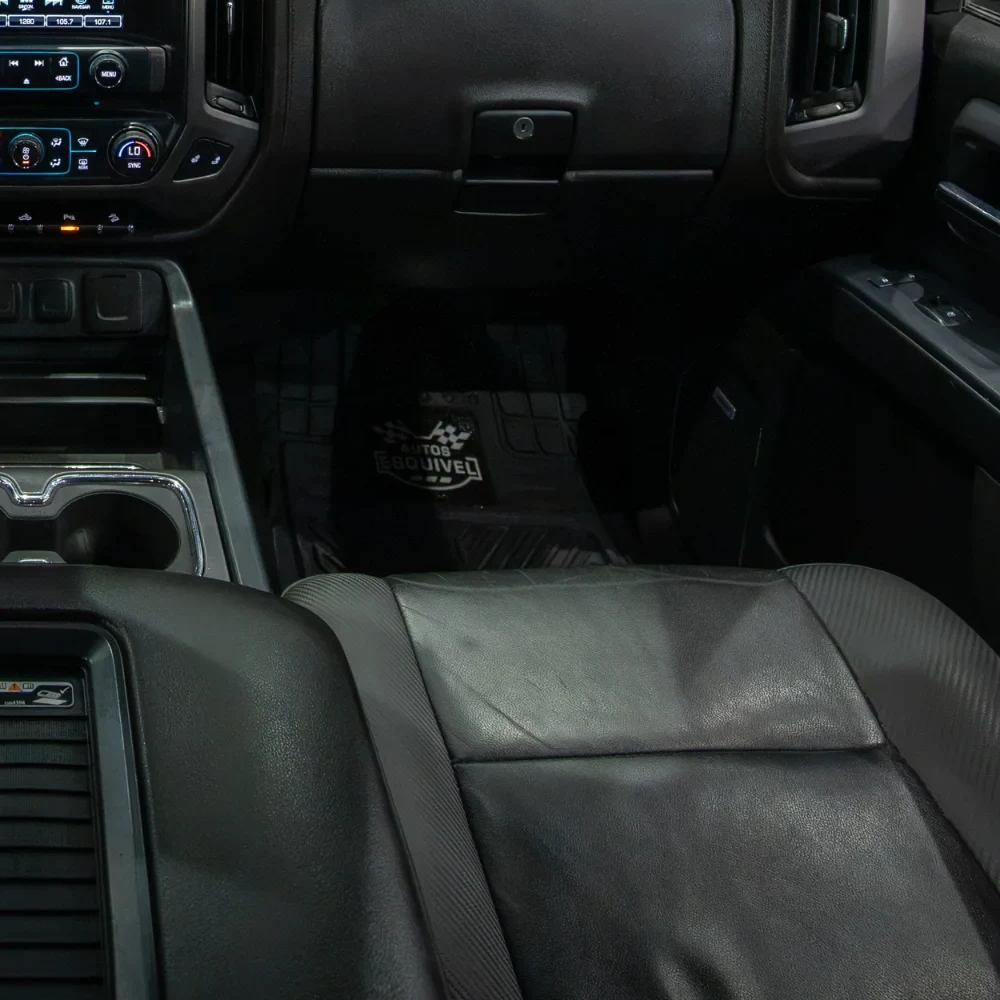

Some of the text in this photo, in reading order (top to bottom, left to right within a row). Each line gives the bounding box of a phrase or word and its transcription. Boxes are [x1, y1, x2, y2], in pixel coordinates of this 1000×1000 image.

[101, 70, 117, 78] MENU
[128, 146, 141, 156] LO
[400, 443, 452, 457] AUTOS
[379, 456, 478, 476] ESQUIVEL
